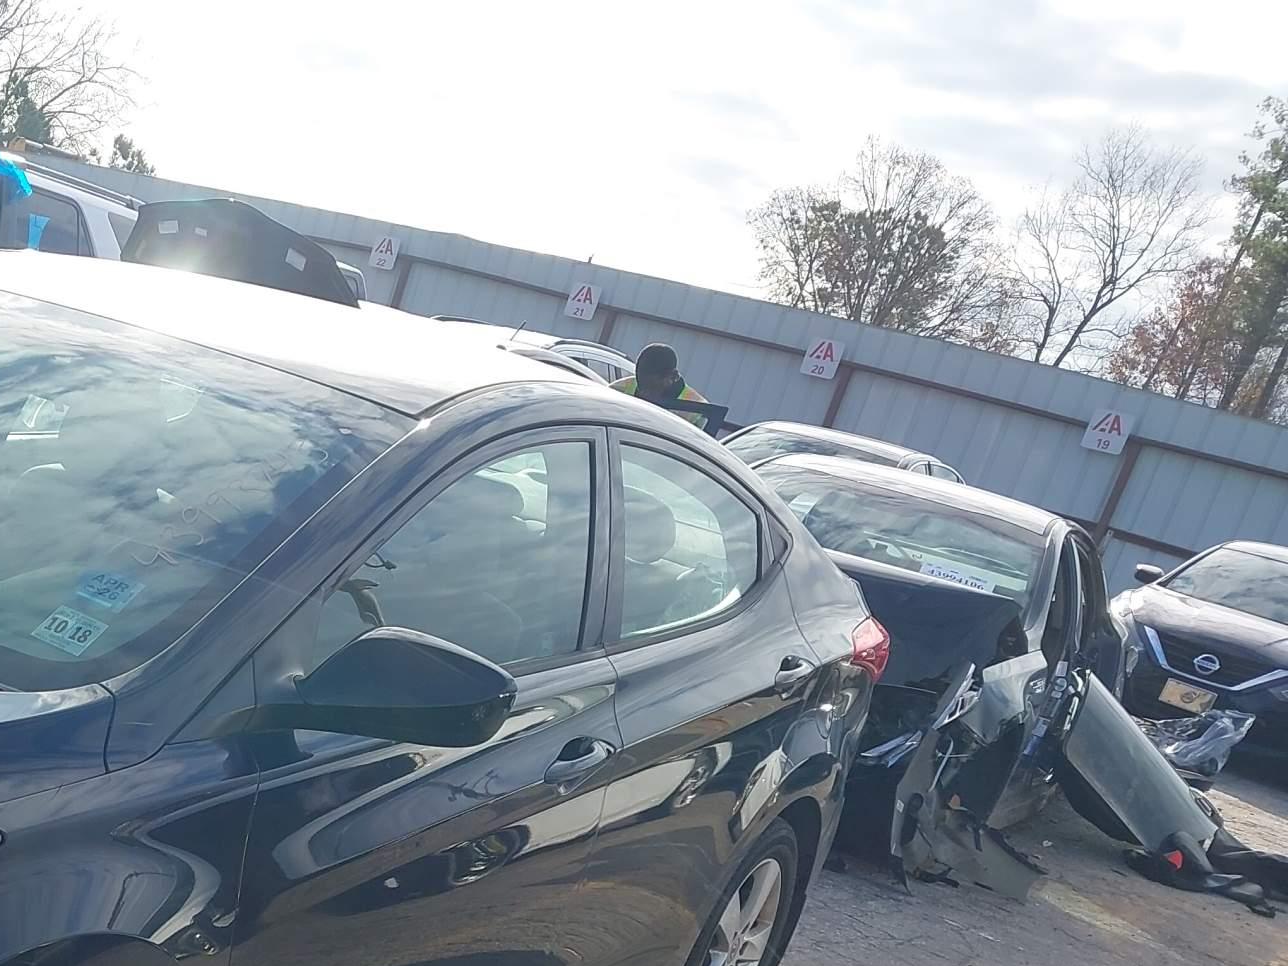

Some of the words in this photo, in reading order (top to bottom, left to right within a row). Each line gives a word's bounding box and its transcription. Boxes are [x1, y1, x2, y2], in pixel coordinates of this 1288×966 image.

[375, 257, 386, 267] 22
[574, 307, 585, 317] 21
[810, 364, 825, 375] 20
[1096, 438, 1111, 450] 19
[91, 573, 130, 593] APR
[44, 616, 70, 634] 10
[67, 626, 93, 644] 18
